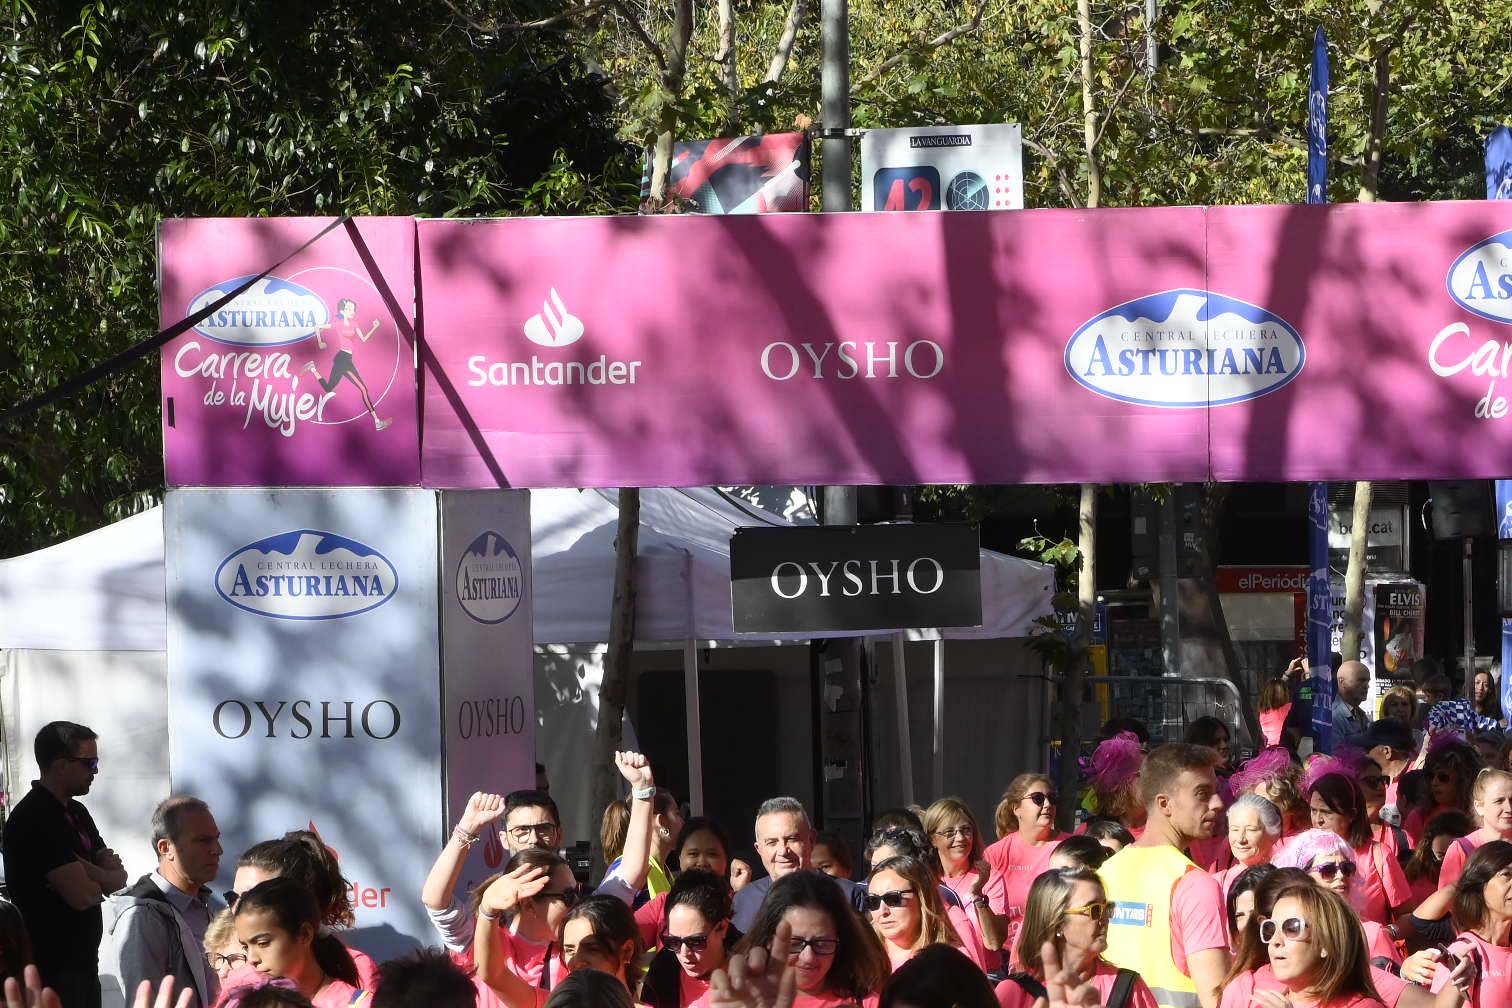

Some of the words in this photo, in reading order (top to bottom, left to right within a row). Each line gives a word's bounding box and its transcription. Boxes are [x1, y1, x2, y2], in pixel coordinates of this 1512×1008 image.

[198, 300, 317, 328] ASTURIANA
[1120, 330, 1197, 342] CENTRAL
[1202, 328, 1280, 341] LECHERA
[174, 341, 294, 380] Carrera
[467, 354, 642, 386] Santander
[760, 339, 945, 381] OYSHO
[1083, 334, 1288, 378] ASTURIANA
[203, 380, 225, 406] de
[230, 379, 246, 406] la
[243, 375, 337, 438] Mujer
[1475, 380, 1509, 420] de
[229, 563, 386, 598] ASTURIANA
[257, 560, 315, 571] CENTRAL
[321, 559, 379, 571] LECHERA
[461, 566, 520, 601] ASTURIANA
[769, 556, 945, 599] OYSHO
[1389, 592, 1421, 606] ELVIS
[212, 698, 401, 740] OYSHO
[458, 695, 525, 741] OYSHO
